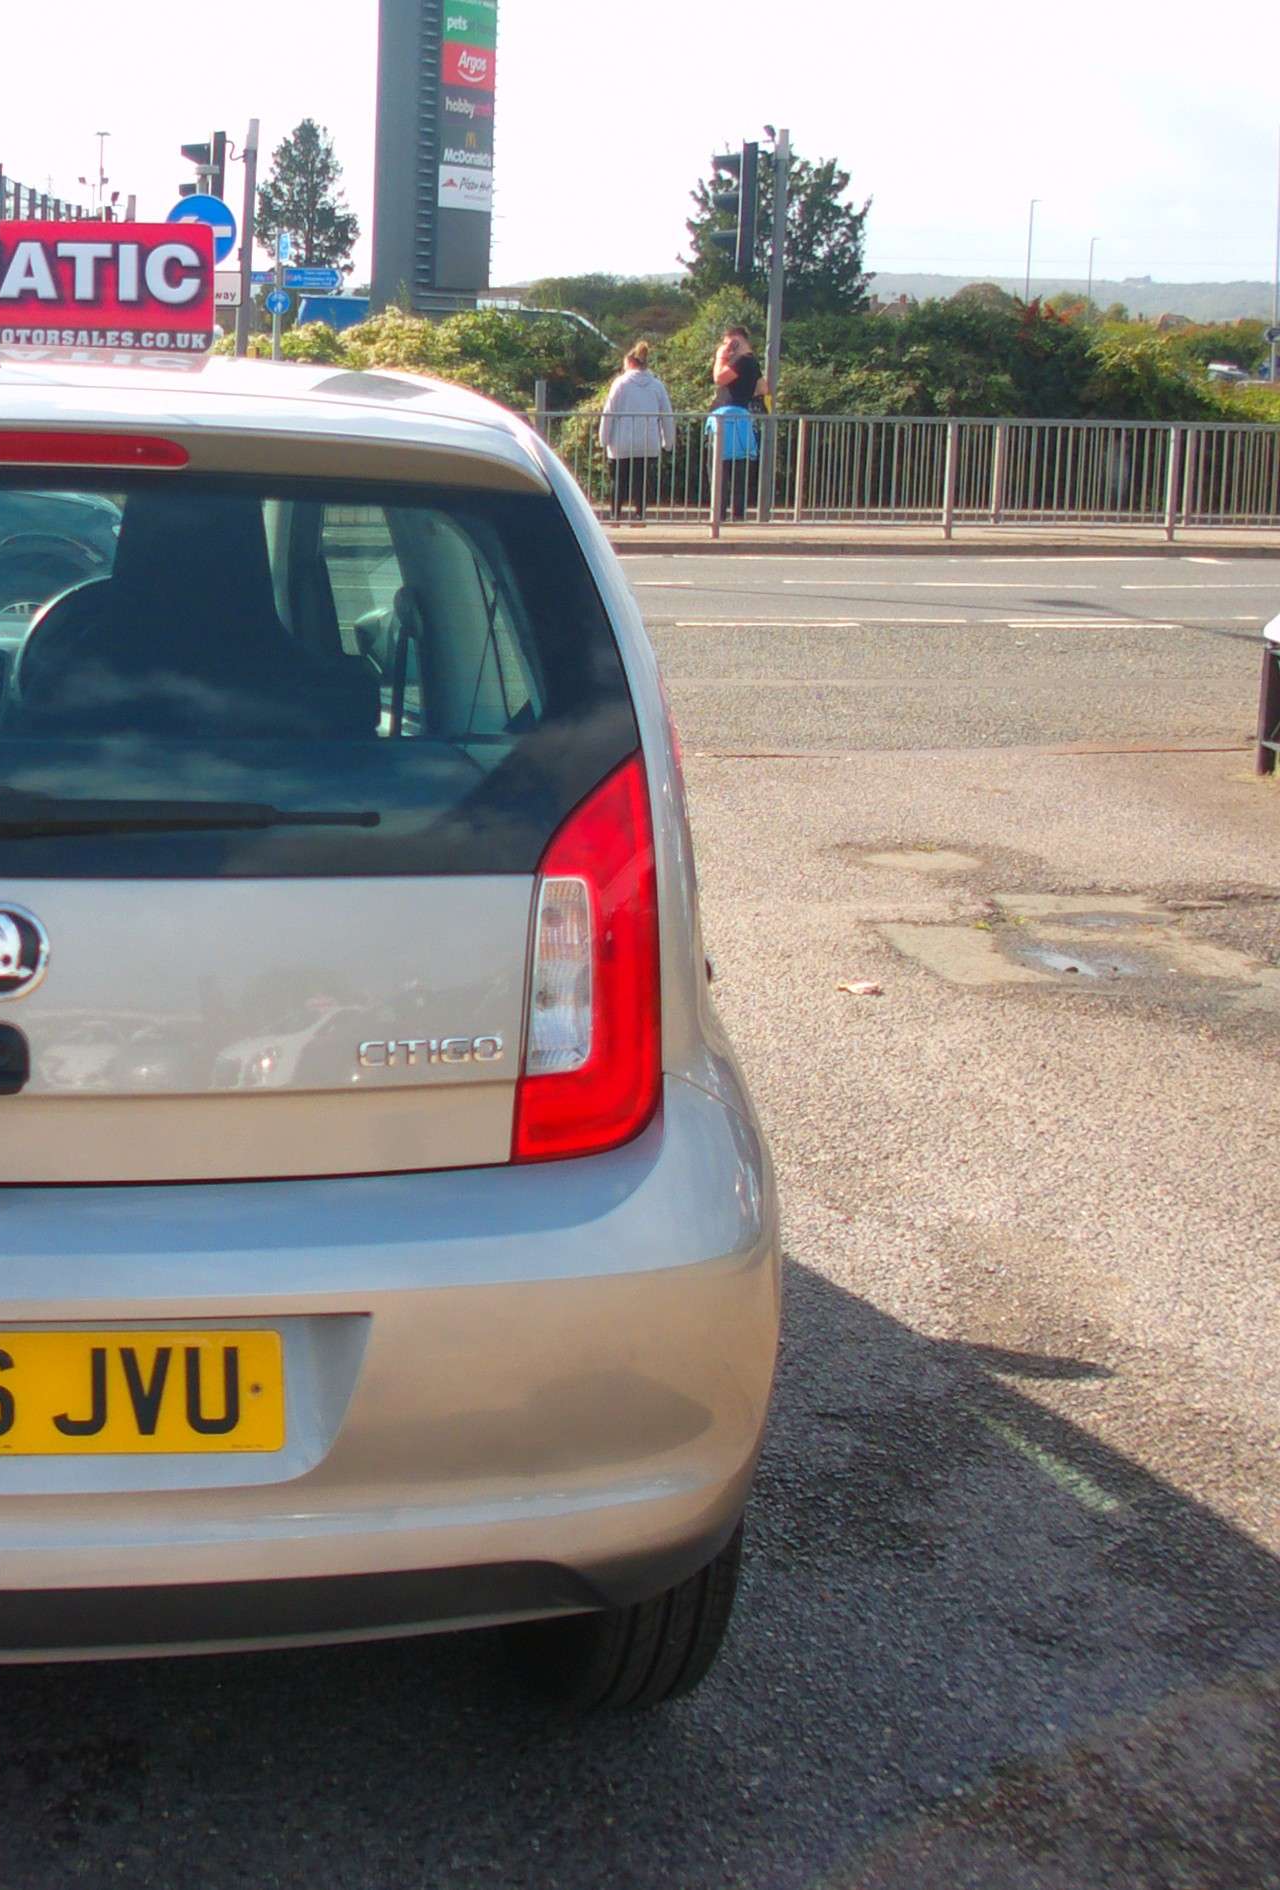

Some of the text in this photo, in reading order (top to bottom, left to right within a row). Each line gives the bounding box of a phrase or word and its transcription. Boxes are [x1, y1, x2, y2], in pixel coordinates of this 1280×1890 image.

[457, 50, 487, 74] Argos
[359, 1036, 504, 1067] CITIGO
[52, 1347, 239, 1436] JVU
